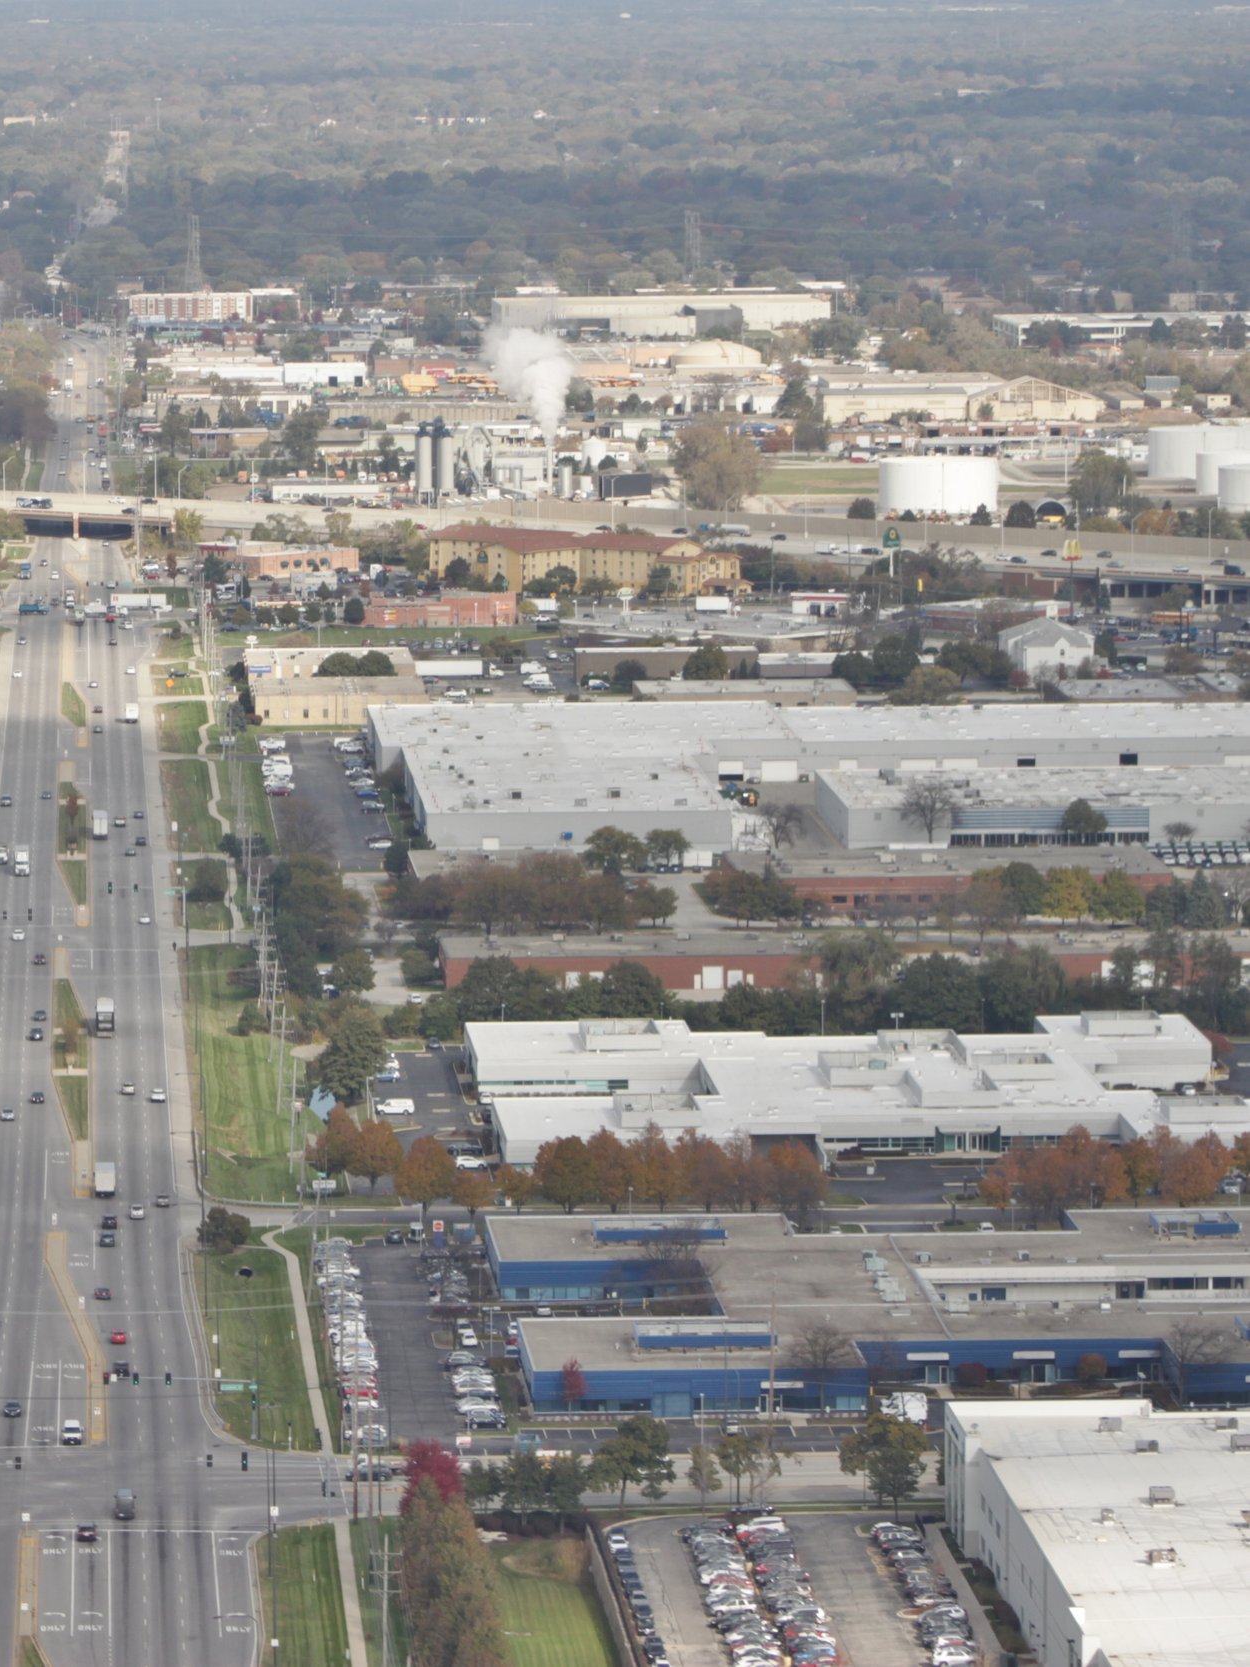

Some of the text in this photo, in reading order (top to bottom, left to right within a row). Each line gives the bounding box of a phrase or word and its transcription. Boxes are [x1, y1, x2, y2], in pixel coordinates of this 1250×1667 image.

[40, 1623, 66, 1632] ONLY
[78, 1623, 103, 1632] ONLY
[225, 1625, 251, 1633] ONLY
